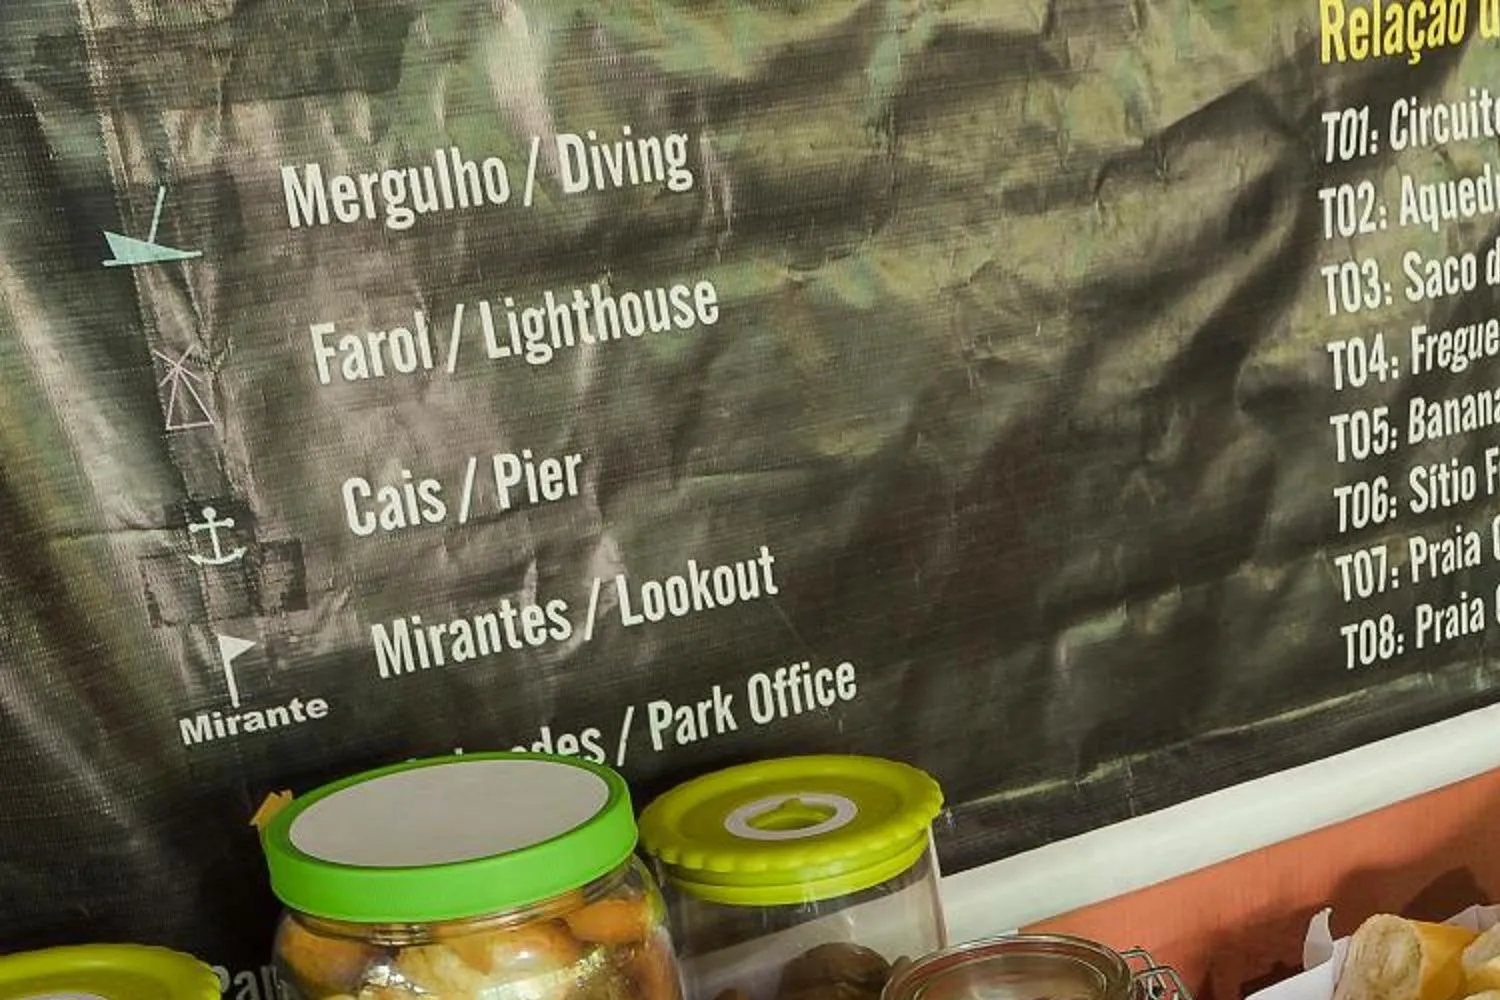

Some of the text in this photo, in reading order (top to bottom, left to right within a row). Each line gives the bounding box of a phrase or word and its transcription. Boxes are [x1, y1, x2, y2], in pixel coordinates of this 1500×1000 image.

[1322, 106, 1377, 162] T01:
[280, 130, 691, 229] Mergulho / Diving
[1319, 181, 1387, 239] T02:
[1322, 264, 1394, 316] T03:
[1404, 251, 1476, 301] Saco
[310, 281, 718, 384] Farol / Lighthouse
[1328, 340, 1399, 392] T04:
[1330, 407, 1396, 462] T05:
[343, 450, 581, 535] Cais / Pier
[1334, 483, 1397, 533] T06:
[1410, 458, 1475, 512] Sítio
[1335, 545, 1398, 601] T07:
[1410, 532, 1481, 584] Praia
[371, 545, 778, 677] Mirantes / Lookout
[1340, 620, 1405, 670] T08:
[1417, 592, 1484, 648] Praia
[180, 698, 328, 744] Mirante
[618, 706, 634, 766] /
[648, 686, 736, 750] Park
[748, 662, 856, 723] Office
